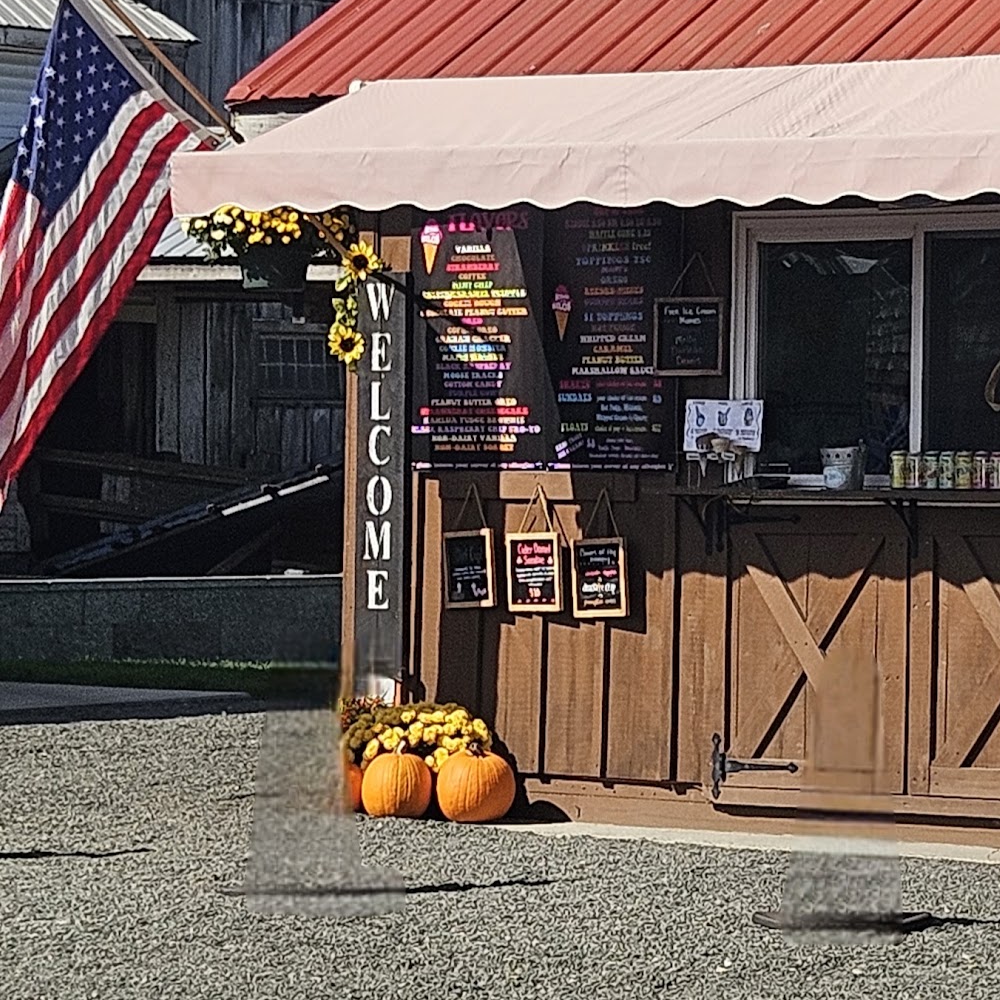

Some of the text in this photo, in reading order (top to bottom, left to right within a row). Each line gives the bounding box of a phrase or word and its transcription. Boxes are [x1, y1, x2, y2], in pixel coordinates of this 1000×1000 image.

[455, 244, 492, 254] VANILLA
[450, 254, 496, 262] CHOCOLATE
[575, 256, 630, 266] TOPPINGS
[457, 272, 487, 280] COFFEE
[474, 280, 494, 289] CHIP
[592, 344, 634, 353] CARAMEL
[581, 355, 613, 365] PEANUT
[443, 371, 470, 380] MOOSE
[443, 380, 474, 389] COTTON
[430, 398, 462, 407] PEANUT
[463, 398, 493, 406] BUTTER
[362, 282, 396, 611] WELCOME
